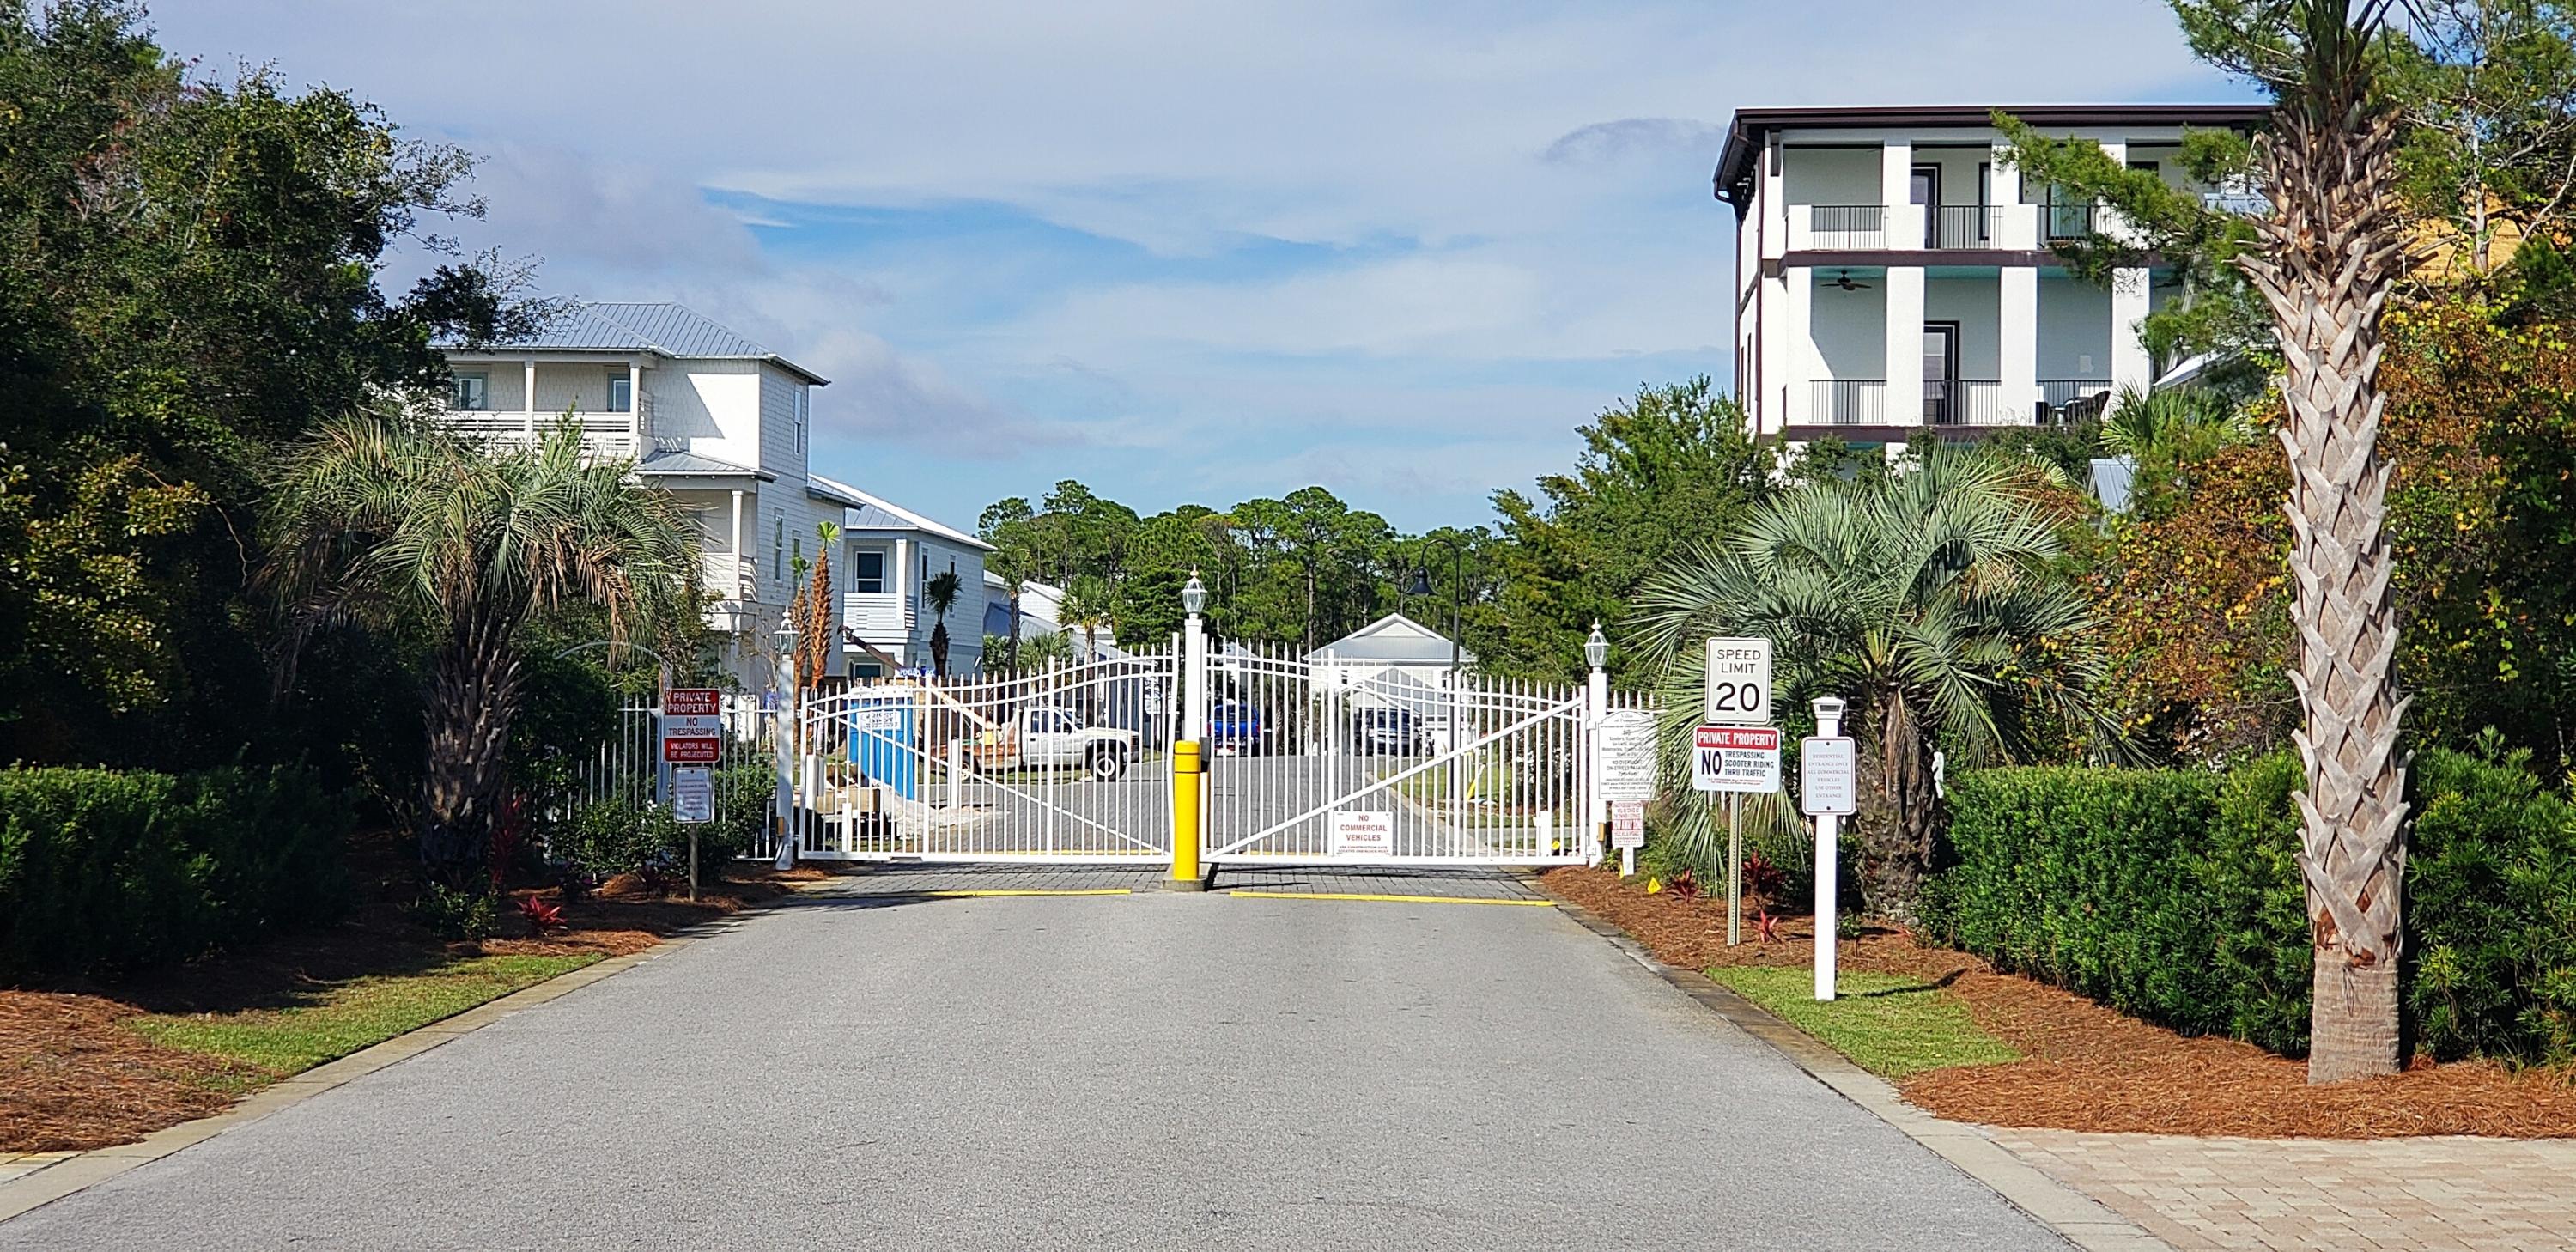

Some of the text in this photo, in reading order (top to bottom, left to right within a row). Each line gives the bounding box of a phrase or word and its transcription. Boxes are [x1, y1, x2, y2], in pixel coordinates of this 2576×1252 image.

[1716, 649, 1761, 660] SPEED
[1721, 662, 1756, 673] LIMIT
[673, 692, 712, 702] PRIVATE
[1716, 682, 1759, 712] 20
[667, 703, 716, 714] PROPERTY
[686, 717, 698, 726] NO
[1698, 732, 1776, 746] PRIVATE PROPERTY
[1724, 751, 1765, 759] TRESPASSING
[1701, 750, 1722, 775] NO
